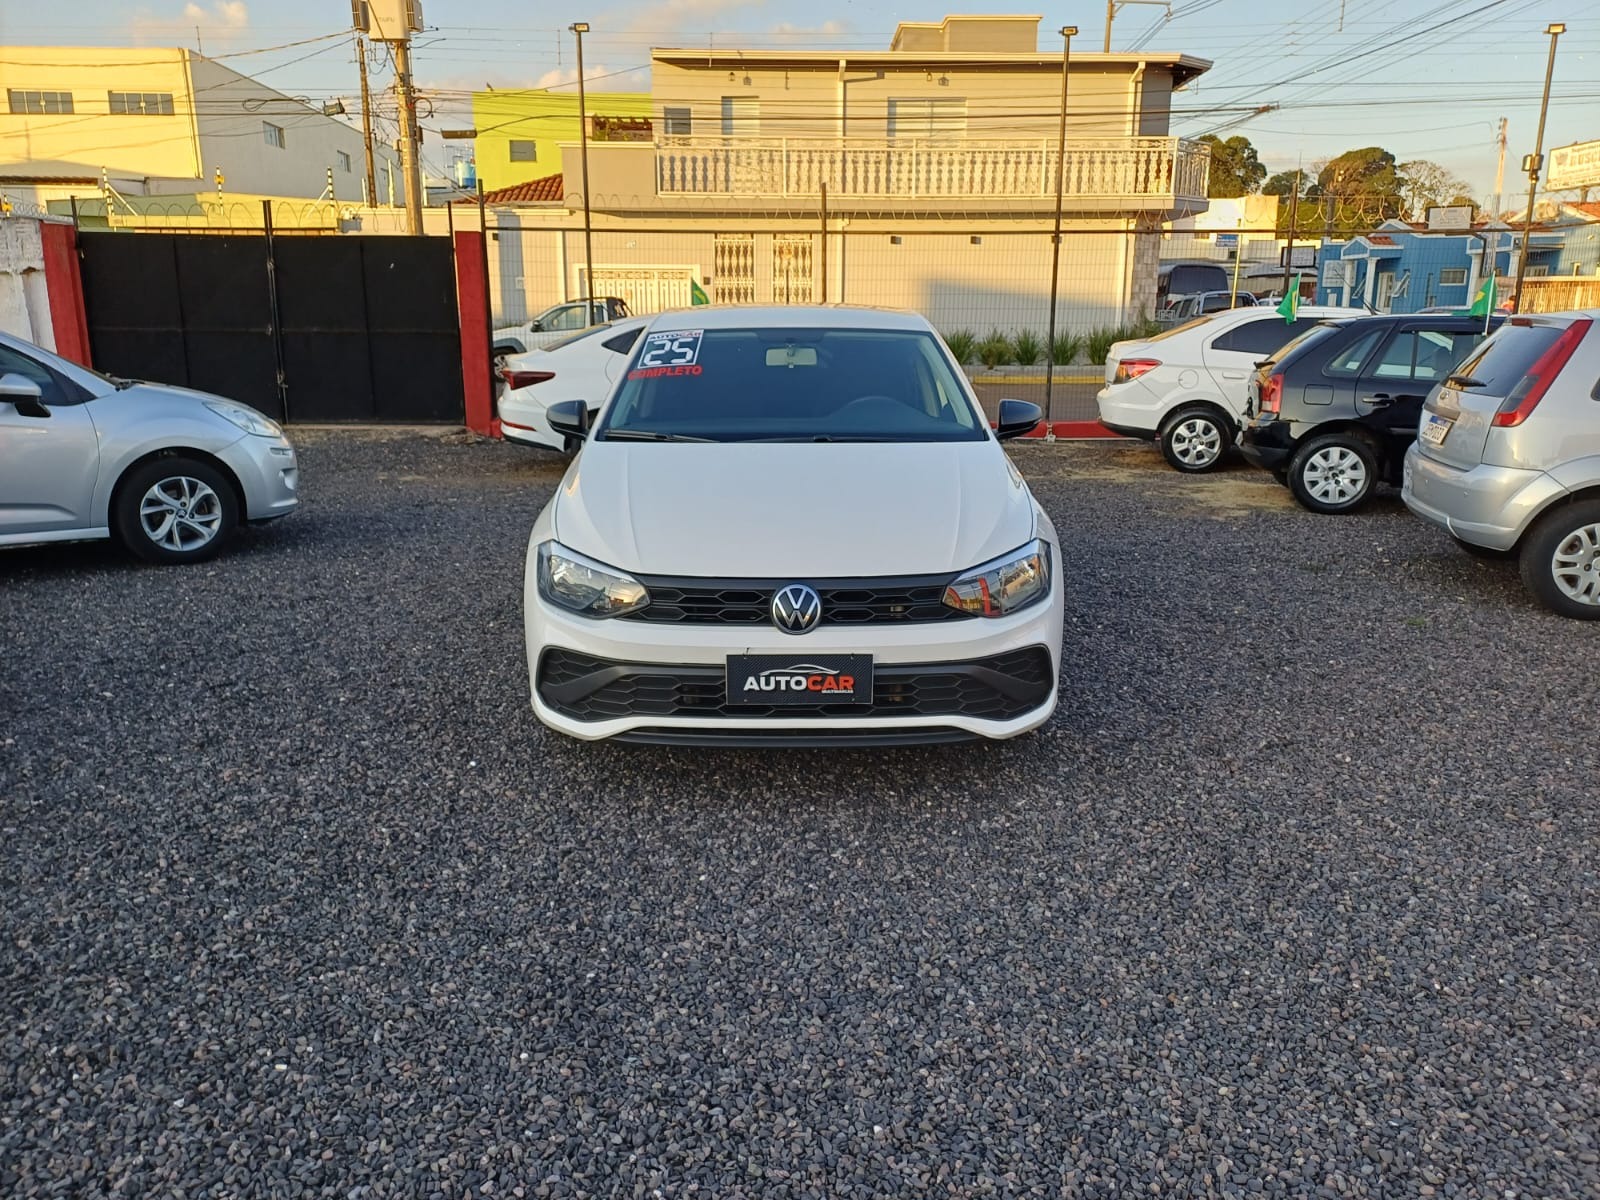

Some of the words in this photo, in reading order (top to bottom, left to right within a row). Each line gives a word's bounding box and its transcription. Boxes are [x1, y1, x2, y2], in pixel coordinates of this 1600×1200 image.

[644, 338, 693, 365] 25
[628, 366, 702, 379] COMPLETO
[743, 676, 854, 691] AUTOCAR
